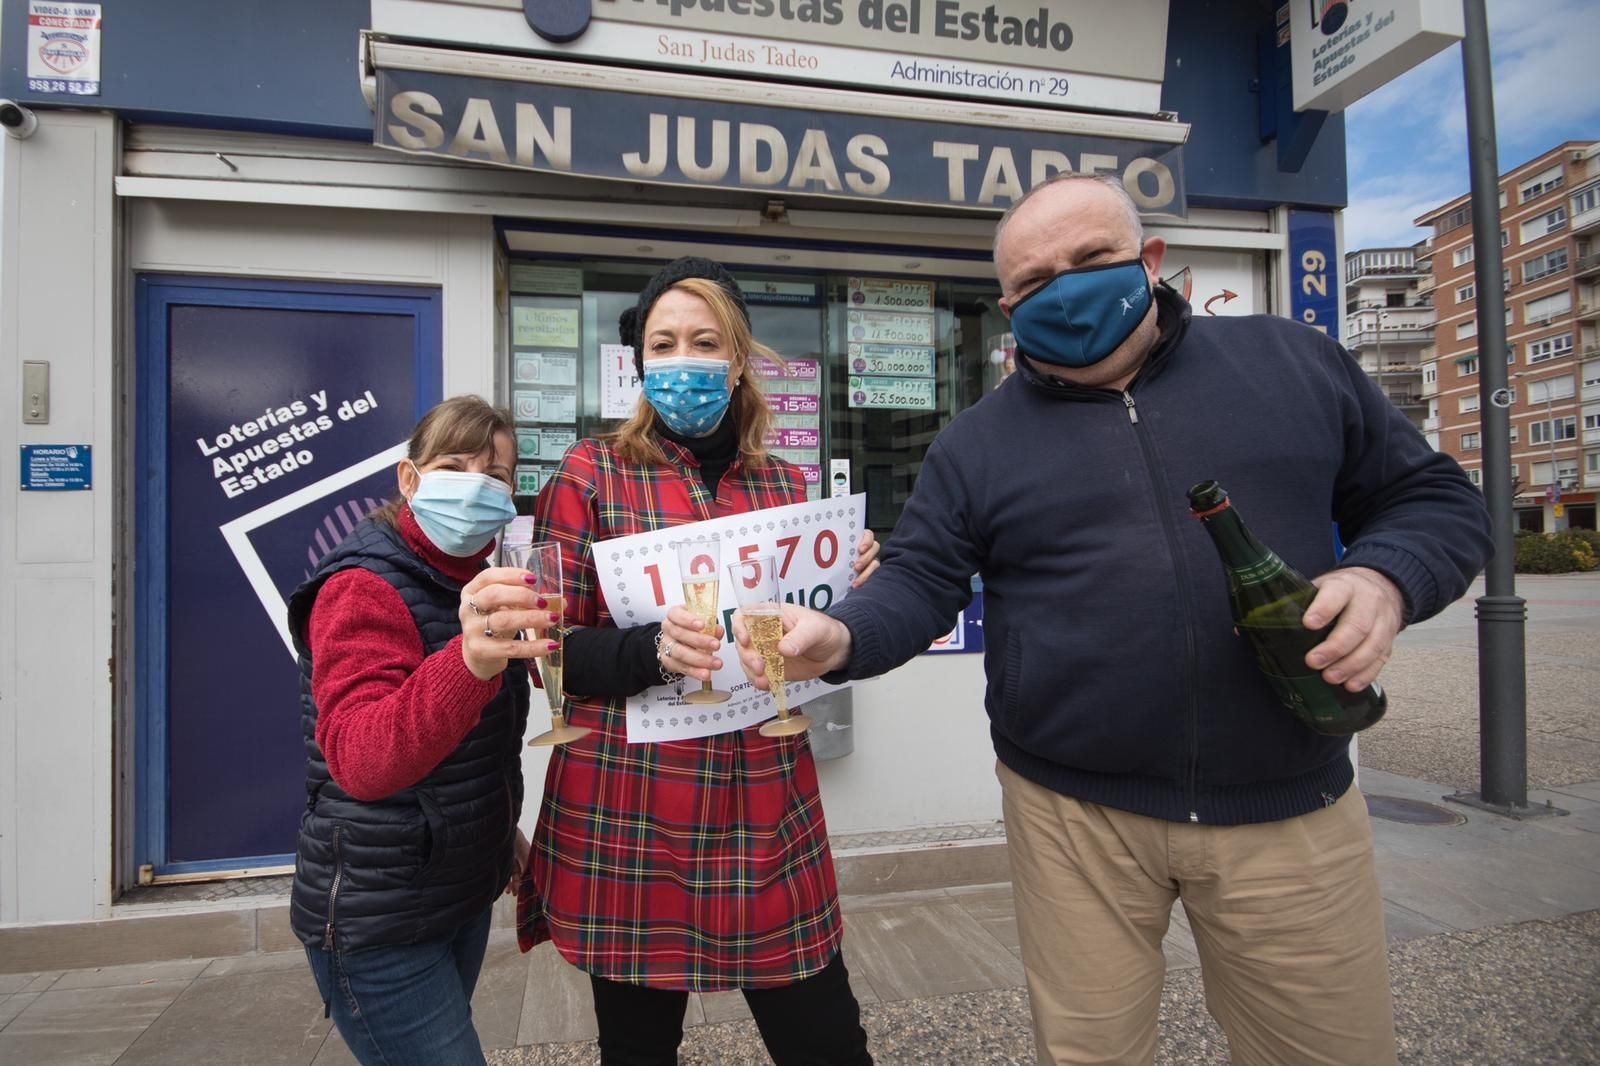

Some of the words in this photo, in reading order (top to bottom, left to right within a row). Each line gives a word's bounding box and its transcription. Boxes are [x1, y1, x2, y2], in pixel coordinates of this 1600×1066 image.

[858, 0, 920, 34] del
[935, 3, 1073, 52] Estado
[1312, 22, 1361, 59] Loterías
[1365, 11, 1374, 26] y
[1313, 30, 1371, 73] Apuestas
[1374, 10, 1395, 33] del
[657, 34, 693, 57] San
[700, 39, 755, 63] Judas
[762, 45, 818, 69] Tadeo
[1313, 54, 1356, 87] Estado
[890, 60, 1023, 92] Administración
[1048, 77, 1069, 97] 29
[387, 90, 572, 171] SAN
[622, 112, 891, 195] JUDAS
[1301, 249, 1327, 296] 29
[196, 401, 308, 456] Loterías
[310, 390, 328, 412] y
[212, 415, 334, 479] Apuestas
[337, 390, 378, 421] del
[220, 449, 314, 499] Estado
